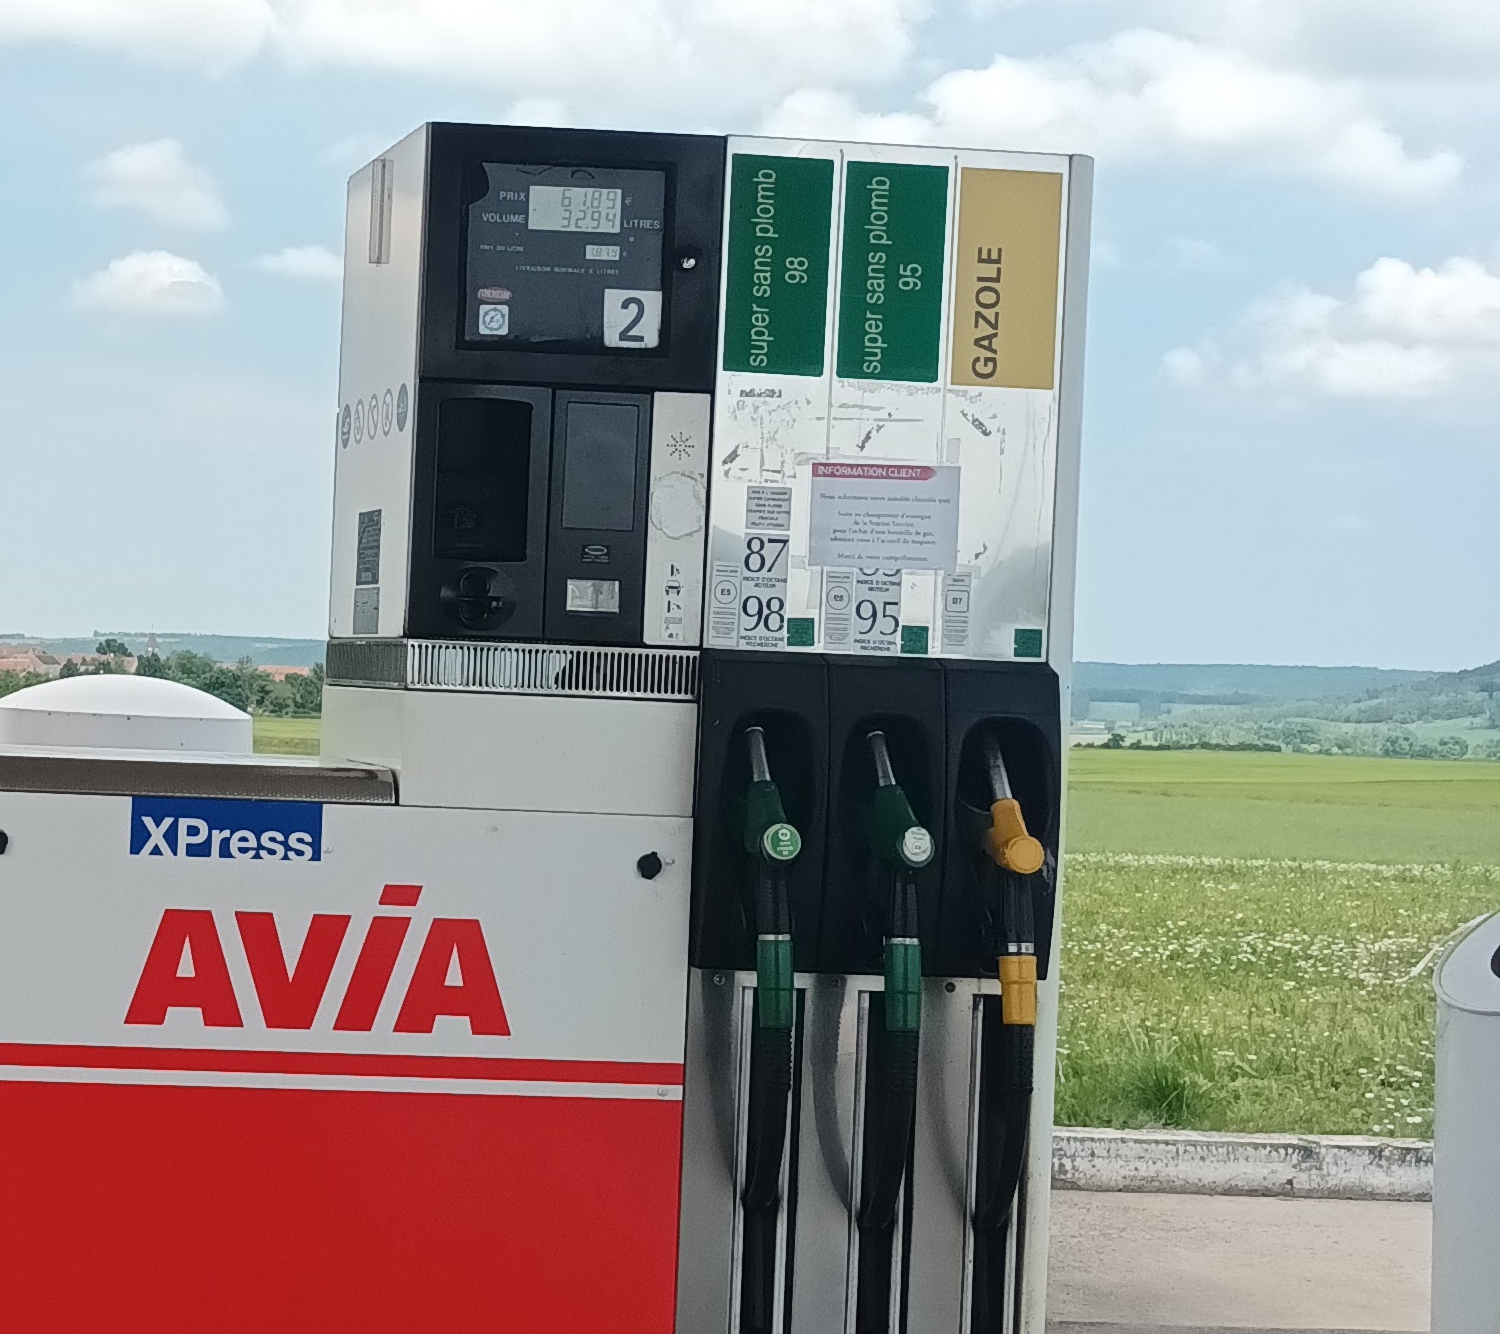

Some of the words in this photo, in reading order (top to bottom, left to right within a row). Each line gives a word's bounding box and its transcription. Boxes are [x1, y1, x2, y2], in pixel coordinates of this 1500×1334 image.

[499, 191, 526, 202] PRIX
[751, 169, 780, 239] plomb
[864, 175, 893, 246] plomb
[481, 212, 526, 224] VOLUME
[623, 219, 661, 230] LITRES
[753, 245, 773, 298] sans
[784, 256, 809, 285] 98
[866, 251, 887, 305] sans
[898, 263, 923, 291] 95
[618, 296, 646, 343] 2
[971, 246, 1003, 381] GAZOLE
[749, 304, 774, 367] super
[862, 310, 888, 375] super
[817, 465, 887, 477] INFORMATION
[888, 467, 922, 478] CLIENT
[743, 536, 790, 573] 87
[720, 587, 732, 596] E5
[741, 595, 785, 633] 98
[855, 598, 900, 636] 95
[138, 815, 314, 863] XPress
